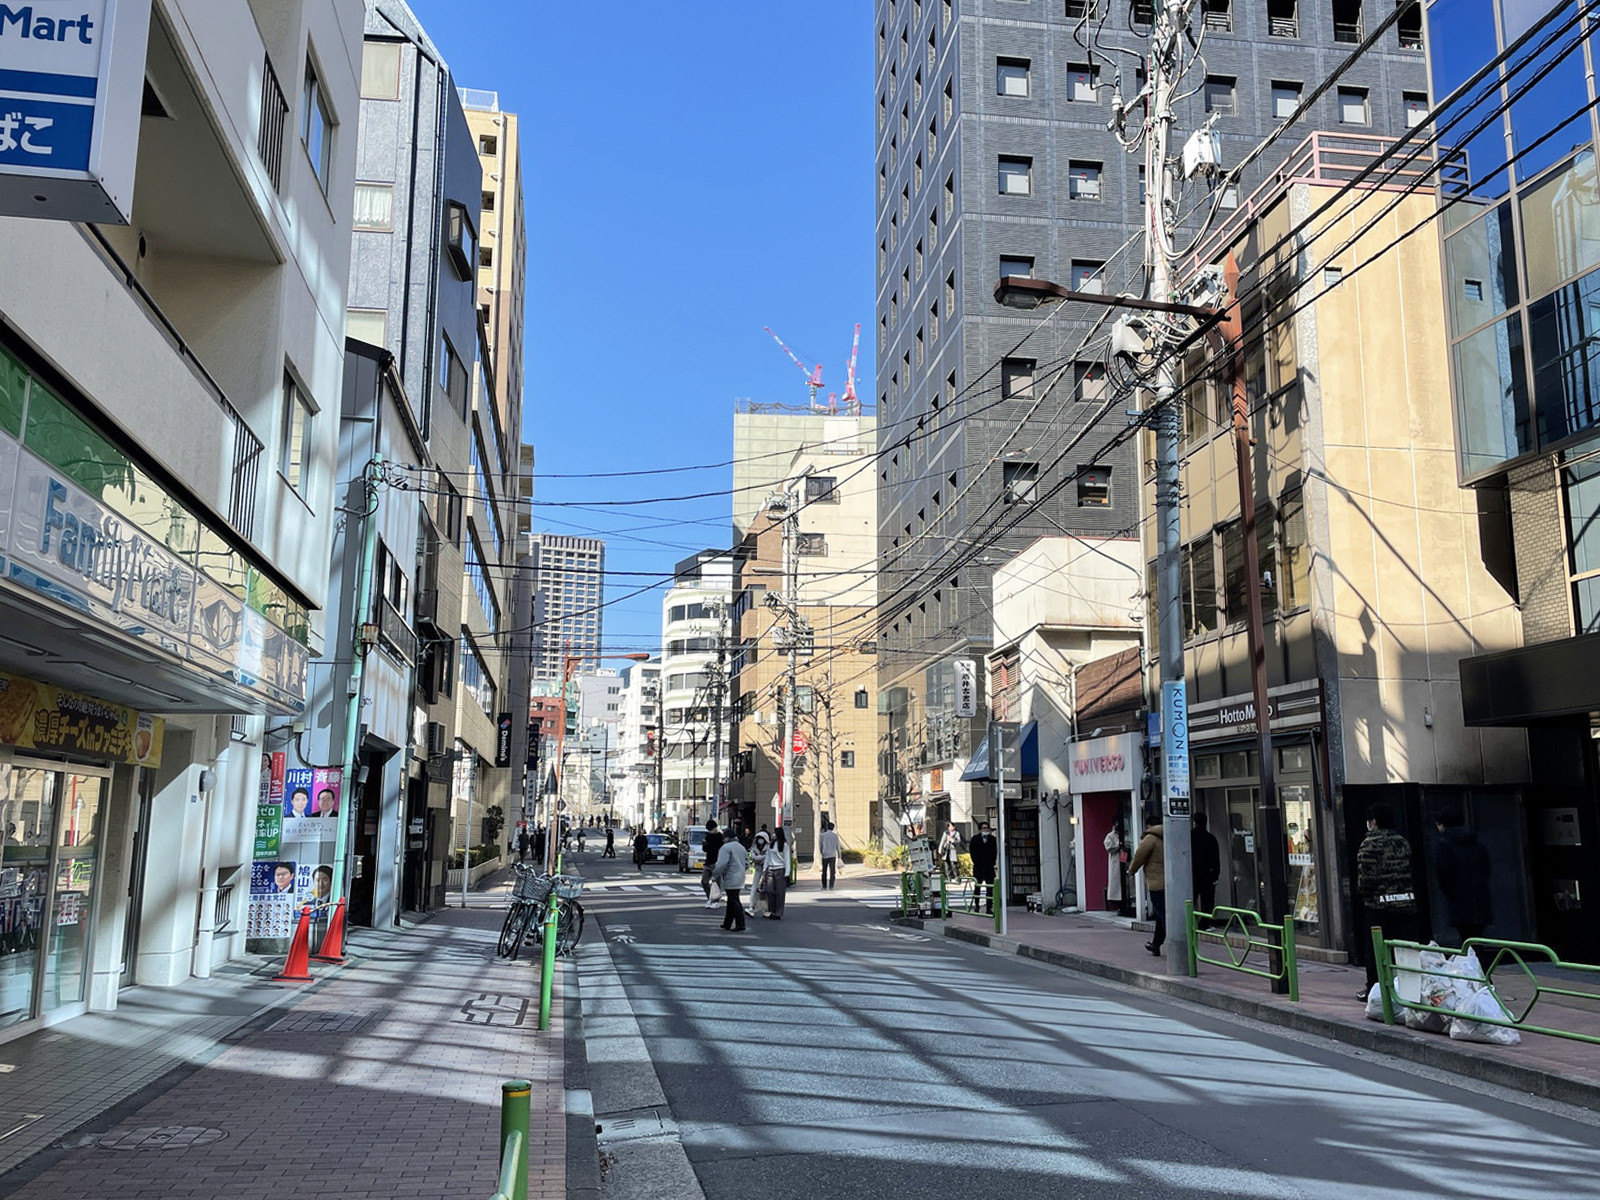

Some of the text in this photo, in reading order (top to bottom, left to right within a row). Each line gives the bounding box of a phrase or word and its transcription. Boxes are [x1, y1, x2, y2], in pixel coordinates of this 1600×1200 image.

[0, 4, 93, 44] Mart
[40, 476, 179, 625] FamilyMart
[1172, 688, 1186, 749] KUMON
[500, 730, 508, 761] Domino's
[287, 771, 313, 783] 川村
